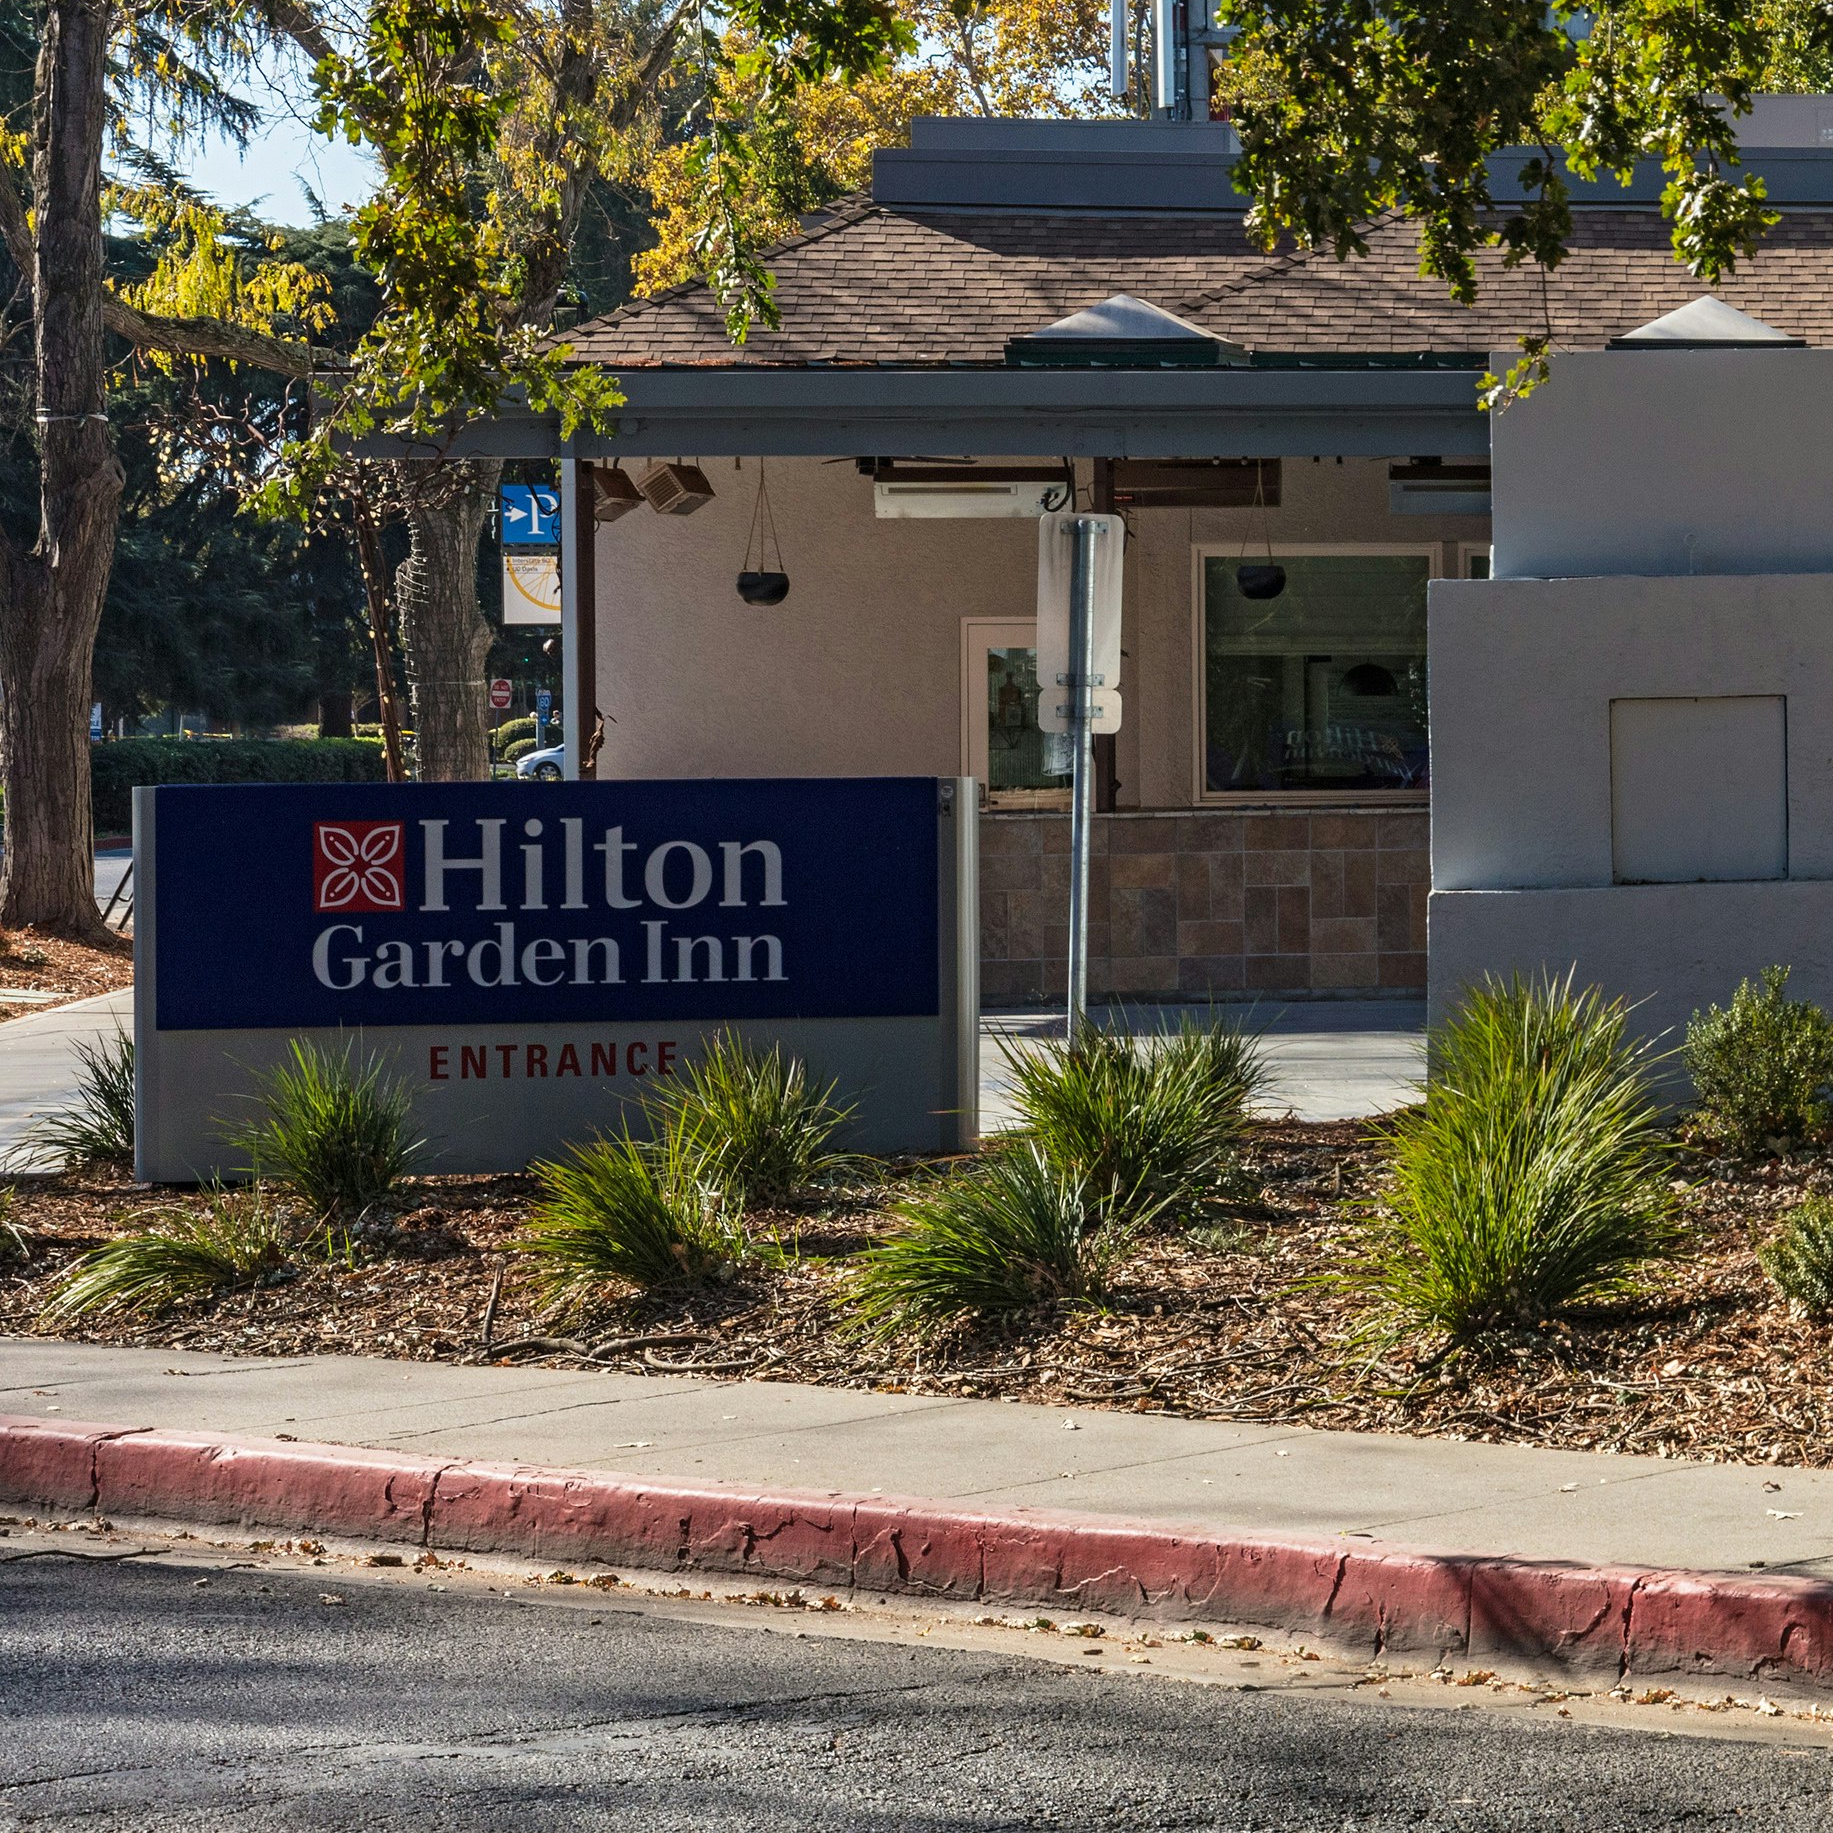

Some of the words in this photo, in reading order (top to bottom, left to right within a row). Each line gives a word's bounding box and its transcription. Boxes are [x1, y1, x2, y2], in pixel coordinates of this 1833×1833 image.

[526, 494, 558, 534] P
[418, 817, 788, 911] Hilton
[312, 922, 627, 990] Garden
[640, 920, 790, 983] Inn
[429, 1041, 678, 1080] ENTRANCE
